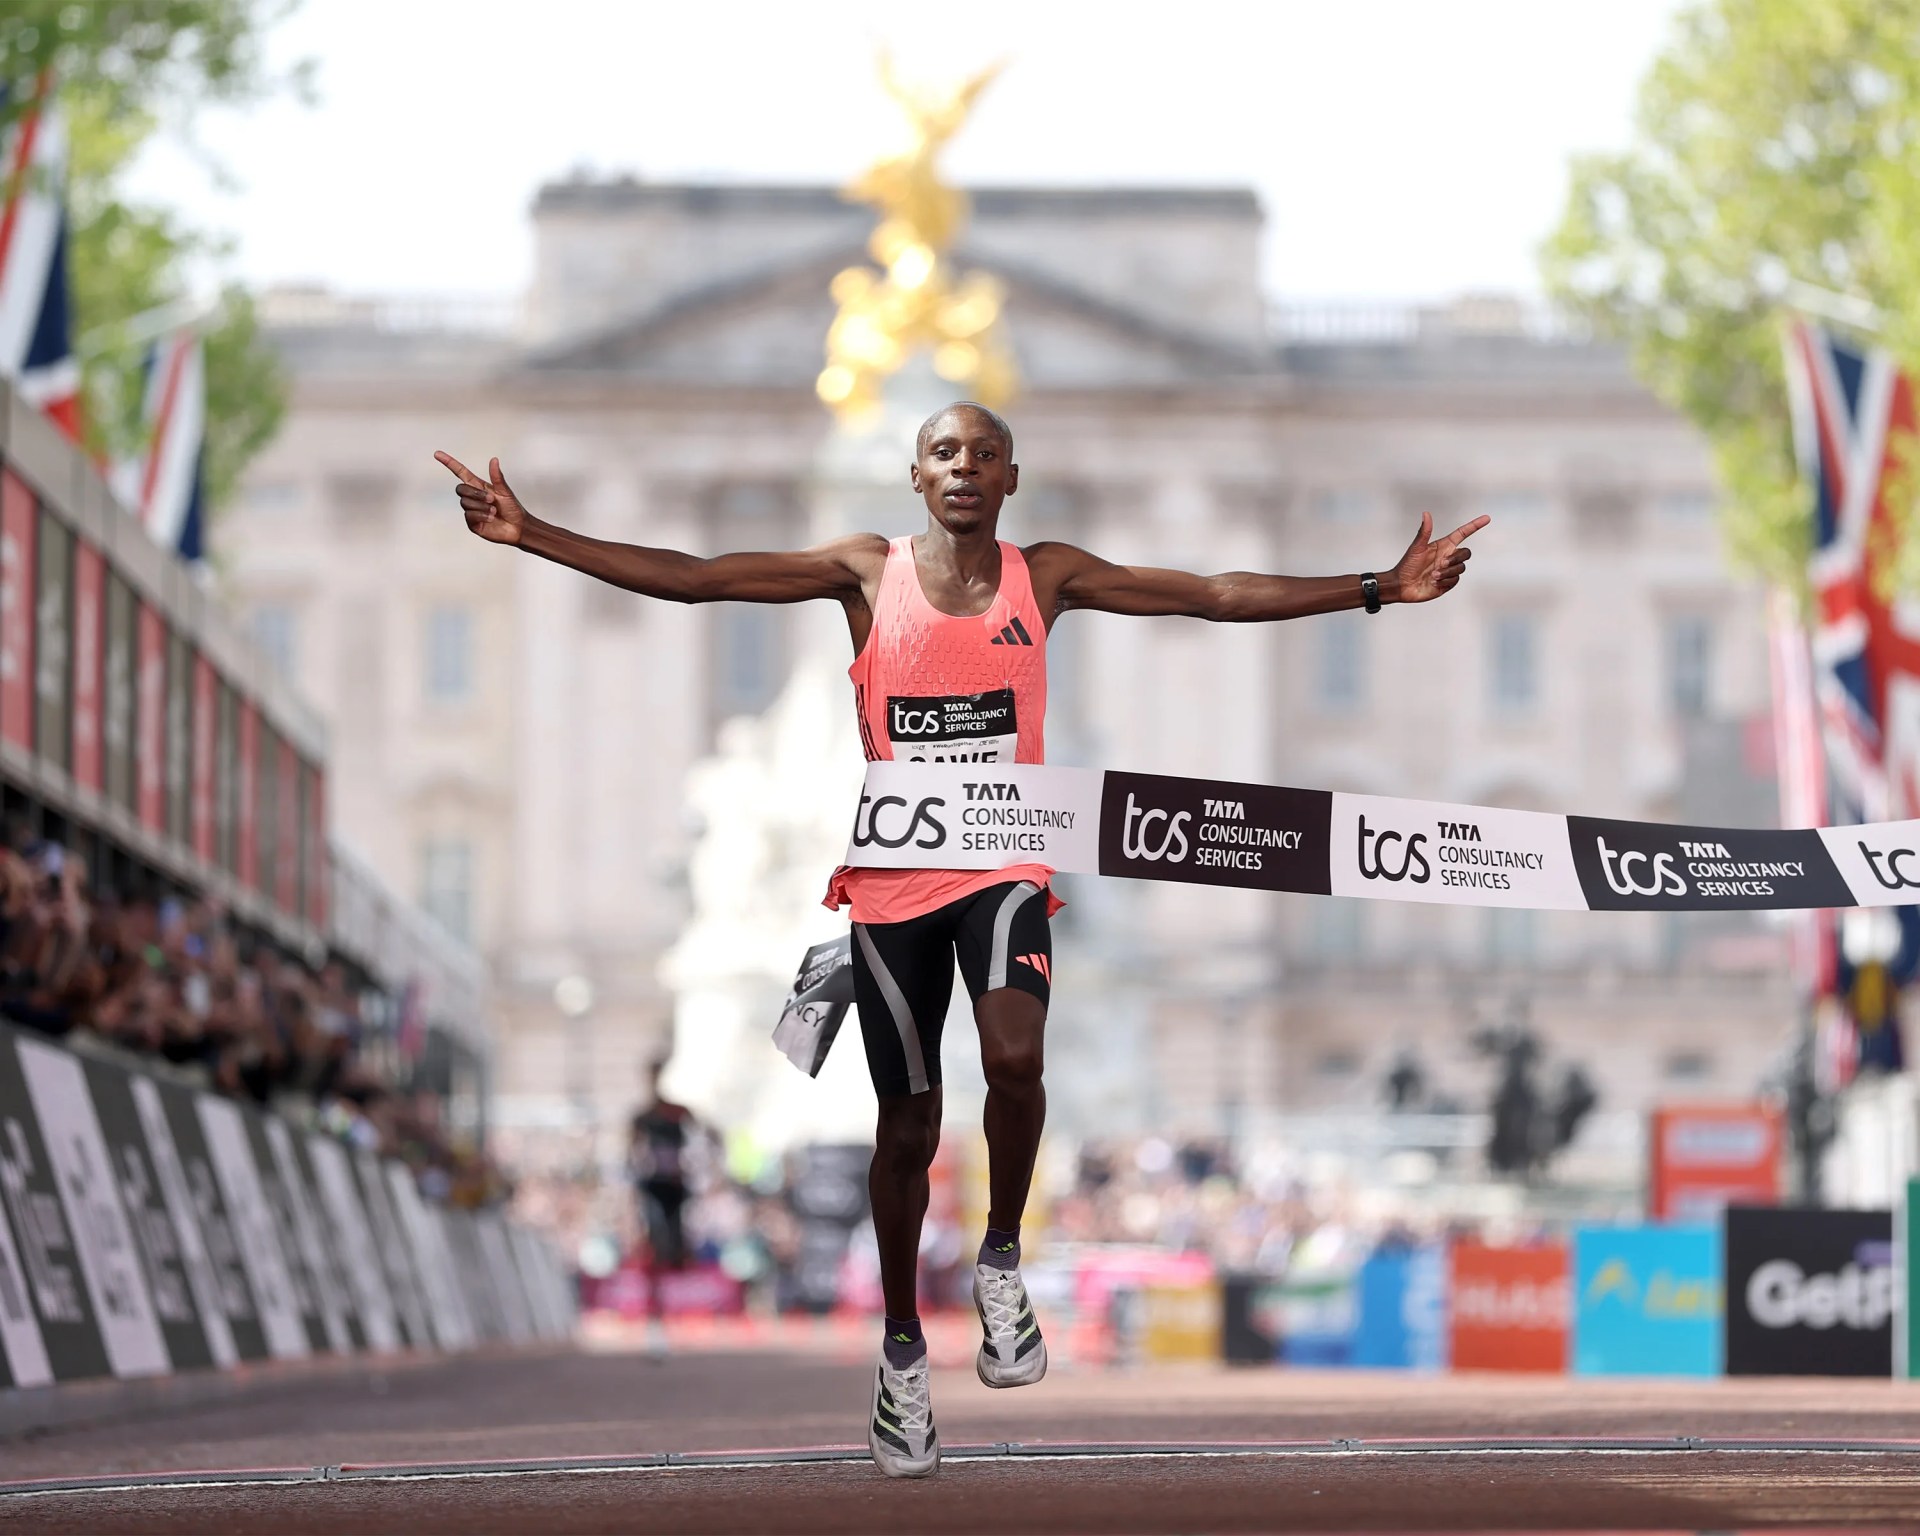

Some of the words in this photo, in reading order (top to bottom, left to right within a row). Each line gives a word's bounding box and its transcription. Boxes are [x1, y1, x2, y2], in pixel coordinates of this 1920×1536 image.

[943, 702, 973, 712] TATA
[944, 708, 1008, 723] CONSULTANCY
[894, 704, 940, 734] tcs
[944, 721, 987, 733] SERVICES
[962, 783, 1021, 801] TATA
[853, 782, 947, 850] tcs
[962, 807, 1076, 830] CONSULTANCY
[1203, 799, 1245, 820] TATA
[1122, 792, 1192, 863] tcs
[1198, 823, 1303, 850] CONSULTANCY
[1437, 821, 1482, 842] TATA
[962, 832, 1045, 851] SERVICES
[1358, 814, 1431, 884] tcs
[1678, 841, 1732, 859] TATA
[1195, 847, 1263, 871] SERVICES
[1438, 845, 1544, 870] CONSULTANCY
[1596, 835, 1688, 896] tcs
[1440, 869, 1511, 890] SERVICES
[1687, 861, 1805, 878] CONSULTANCY
[1696, 881, 1775, 896] SERVICES
